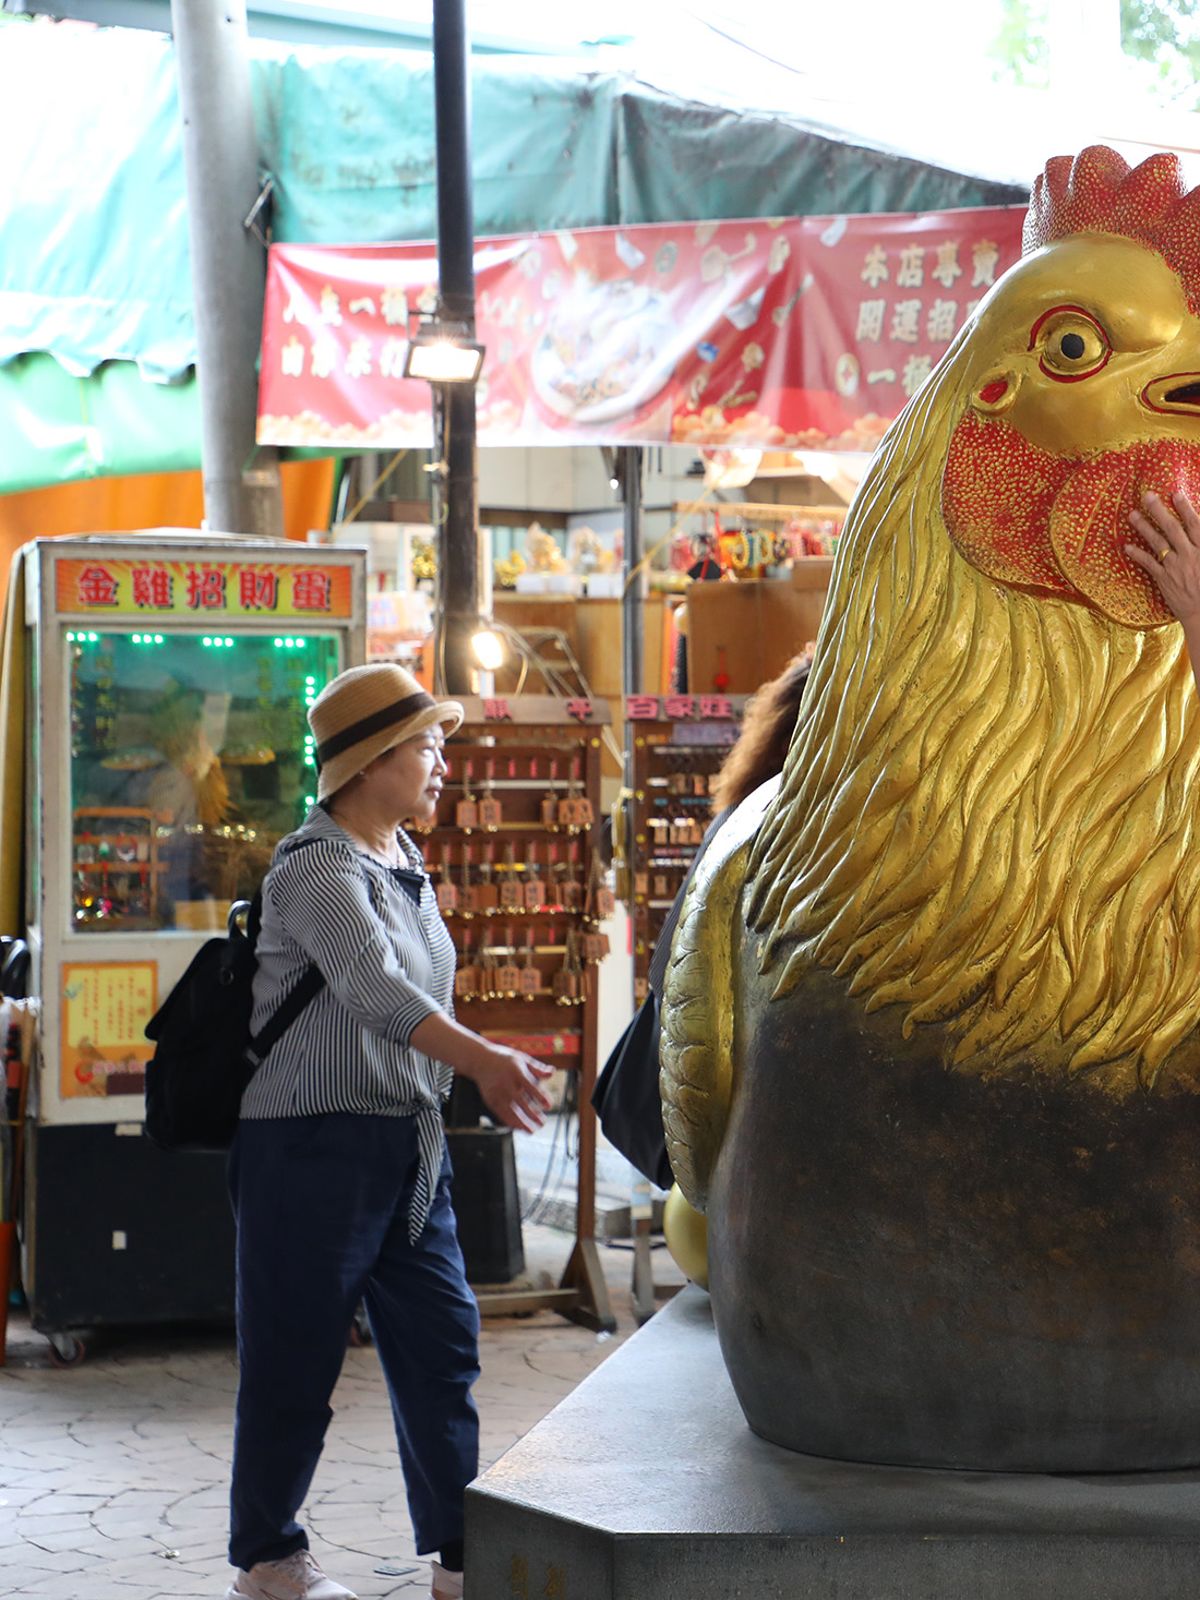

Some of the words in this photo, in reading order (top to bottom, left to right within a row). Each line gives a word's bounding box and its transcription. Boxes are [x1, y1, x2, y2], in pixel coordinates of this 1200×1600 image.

[78, 566, 330, 610] 金雞招財蛋
